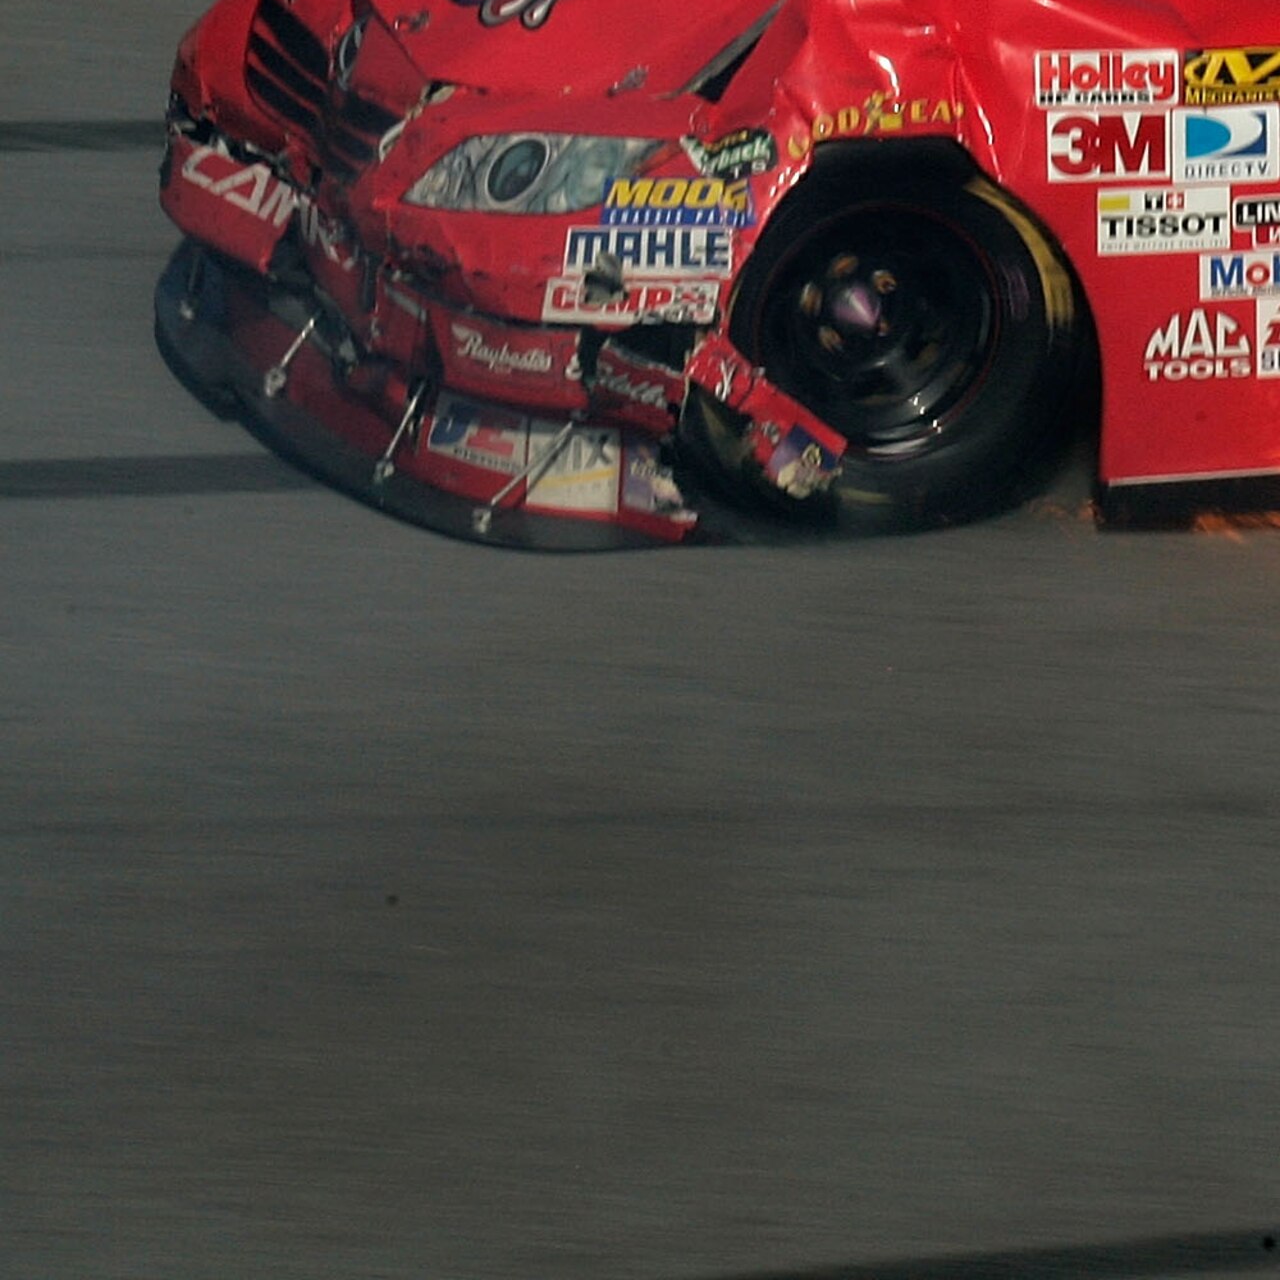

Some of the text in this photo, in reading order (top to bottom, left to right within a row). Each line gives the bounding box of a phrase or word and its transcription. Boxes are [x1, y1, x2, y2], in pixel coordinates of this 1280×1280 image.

[1040, 51, 1175, 100] Holley
[1051, 114, 1166, 176] 3M
[1184, 160, 1269, 180] DIRECTV
[605, 178, 750, 211] MOOG
[1101, 211, 1228, 239] TISSOT
[567, 229, 730, 267] MAHLE
[1146, 309, 1250, 359] MAC
[1146, 359, 1251, 381] TOOLS
